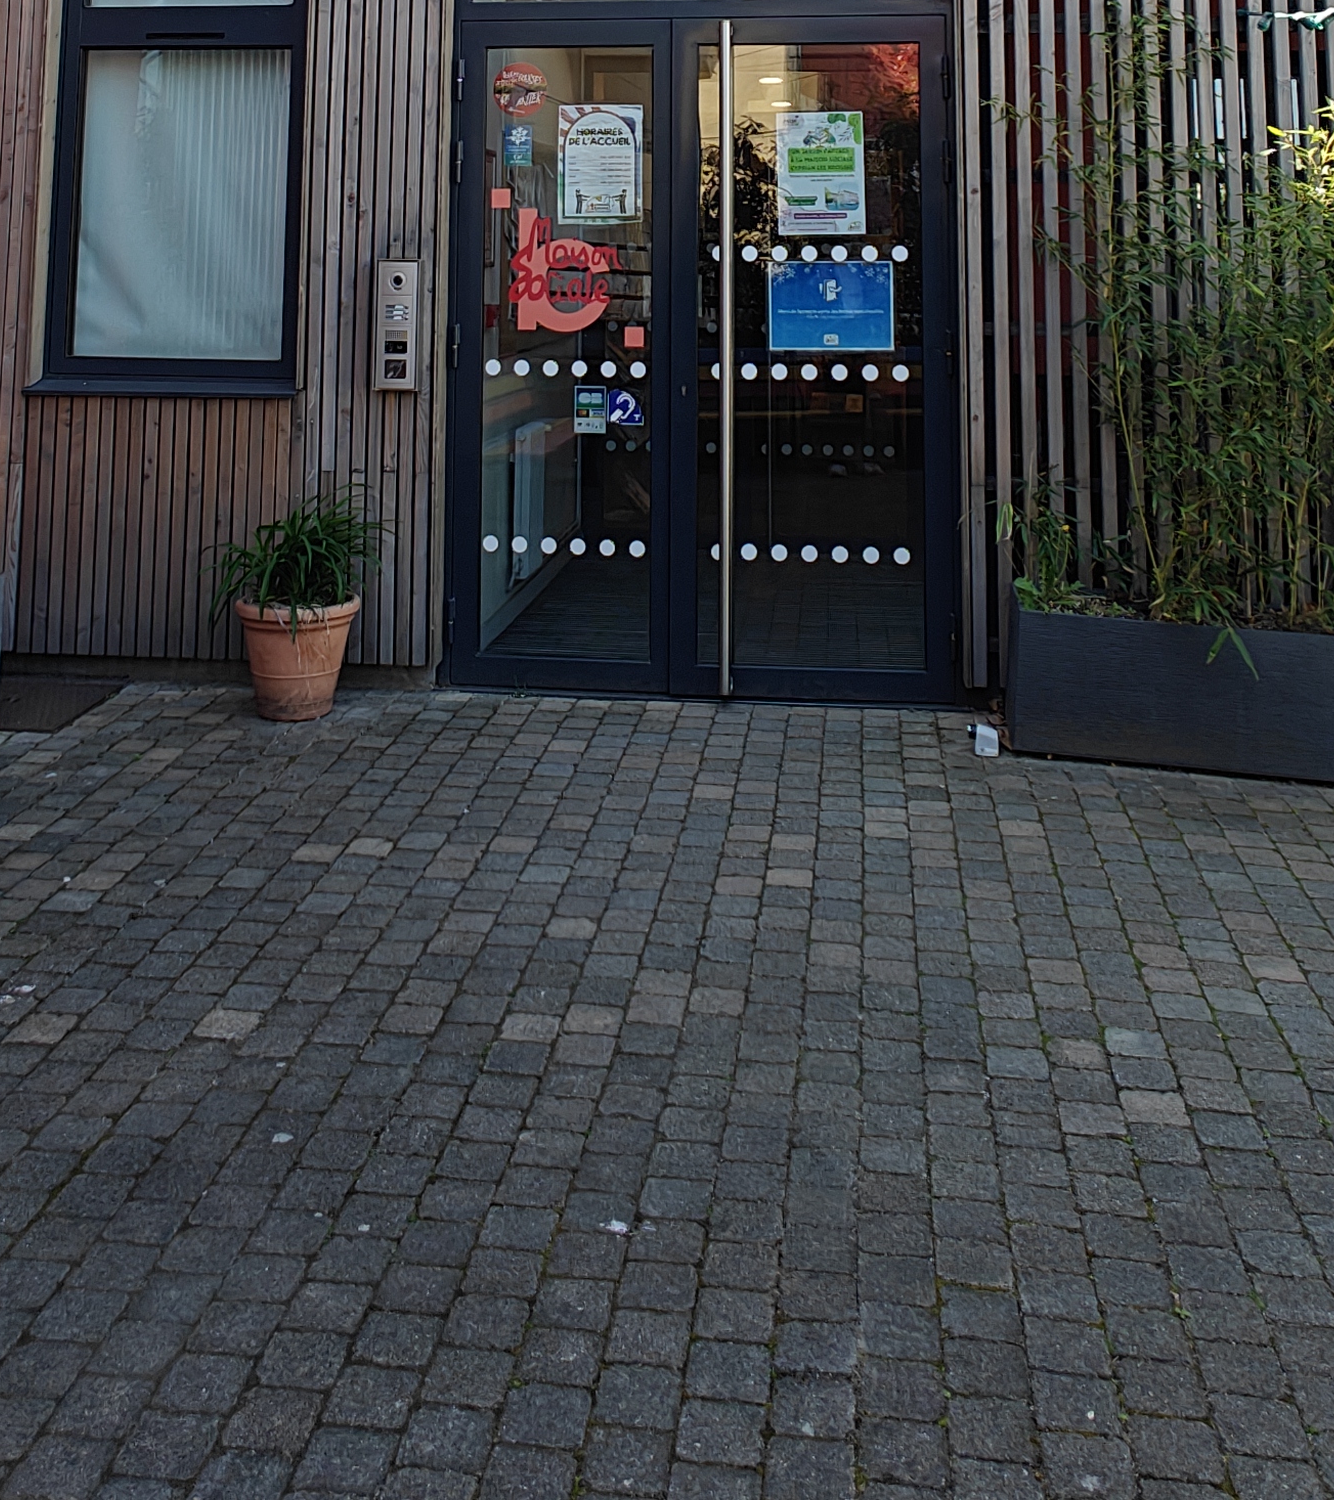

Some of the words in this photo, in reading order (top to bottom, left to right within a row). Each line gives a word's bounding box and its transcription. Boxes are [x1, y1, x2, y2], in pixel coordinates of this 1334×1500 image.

[568, 137, 580, 146] DE
[581, 137, 631, 146] L'ACCUEIL
[576, 128, 623, 136] HORAIRES
[526, 216, 623, 270] Maison
[508, 245, 611, 305] Sociale
